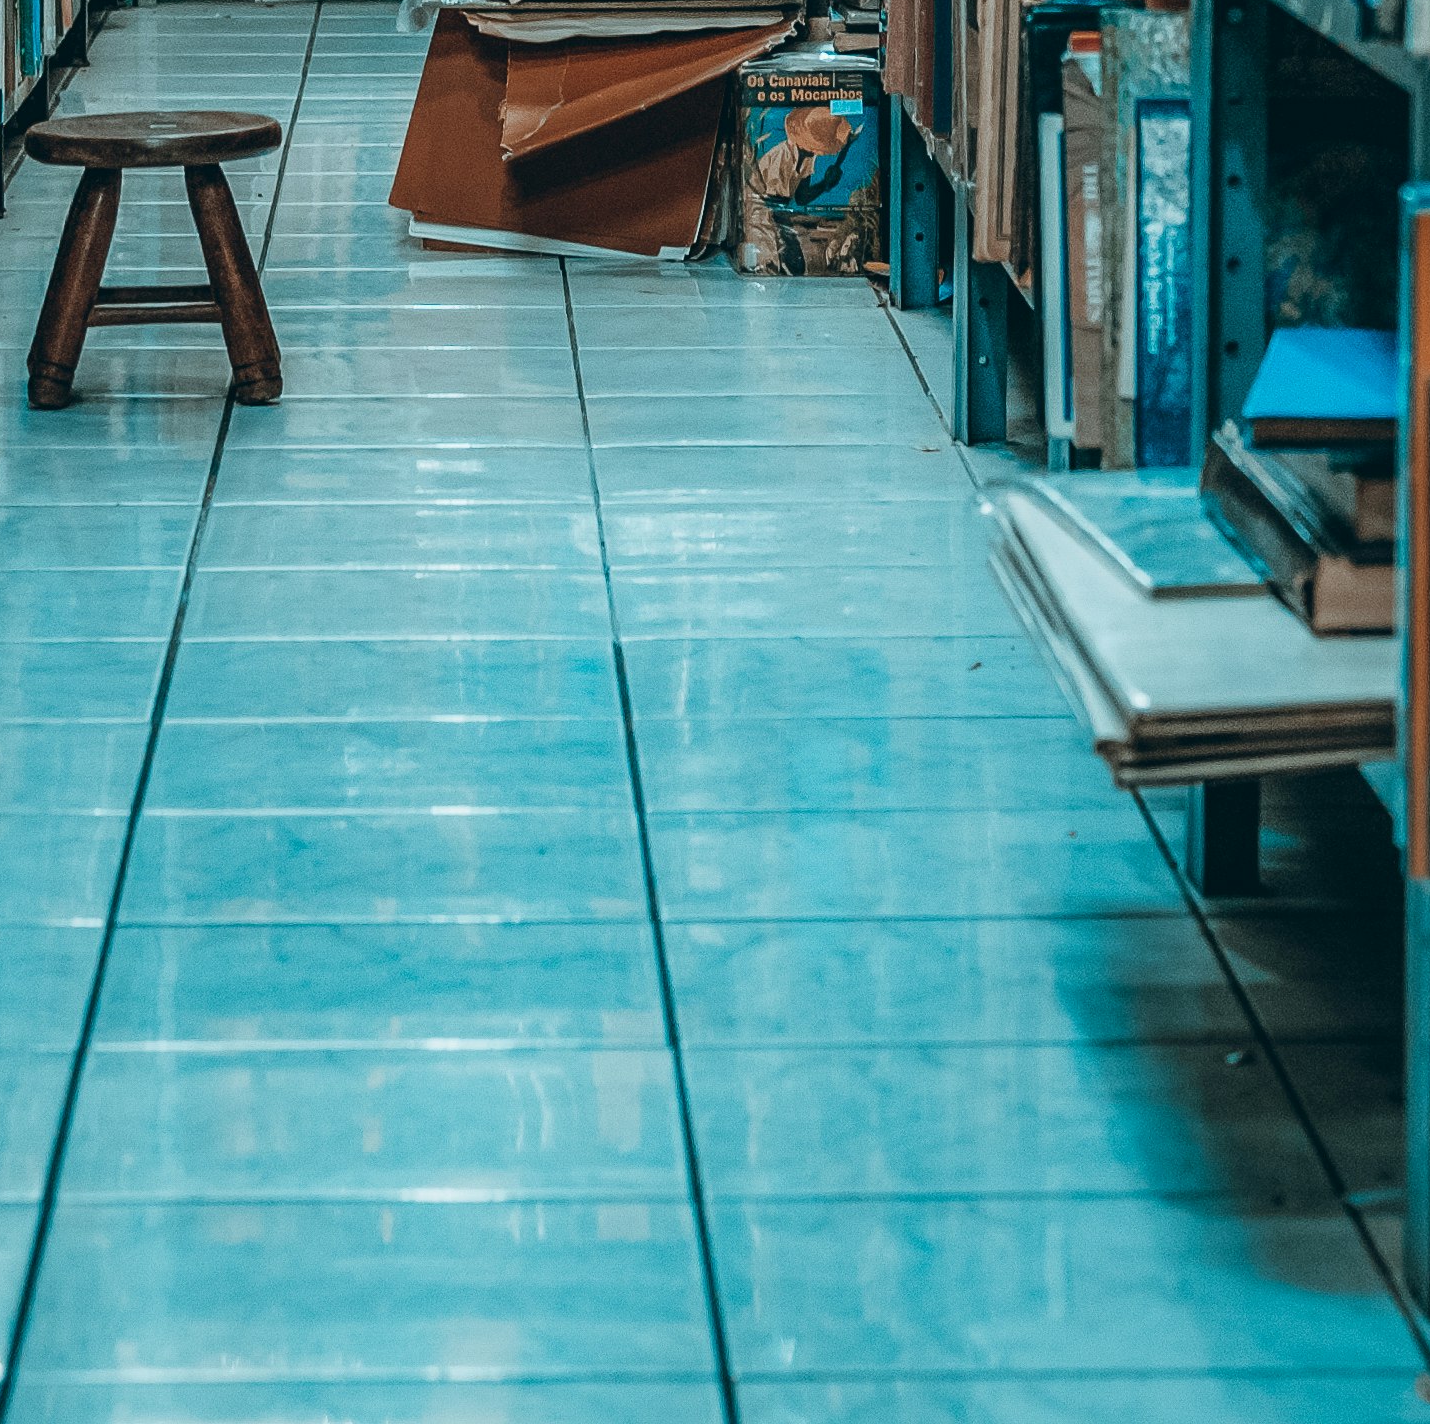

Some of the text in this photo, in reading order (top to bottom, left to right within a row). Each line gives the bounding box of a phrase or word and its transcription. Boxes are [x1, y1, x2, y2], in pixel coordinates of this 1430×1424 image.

[747, 74, 765, 88] Os
[769, 73, 830, 88] Canaviais
[769, 91, 786, 102] os
[790, 88, 863, 102] Mocambos
